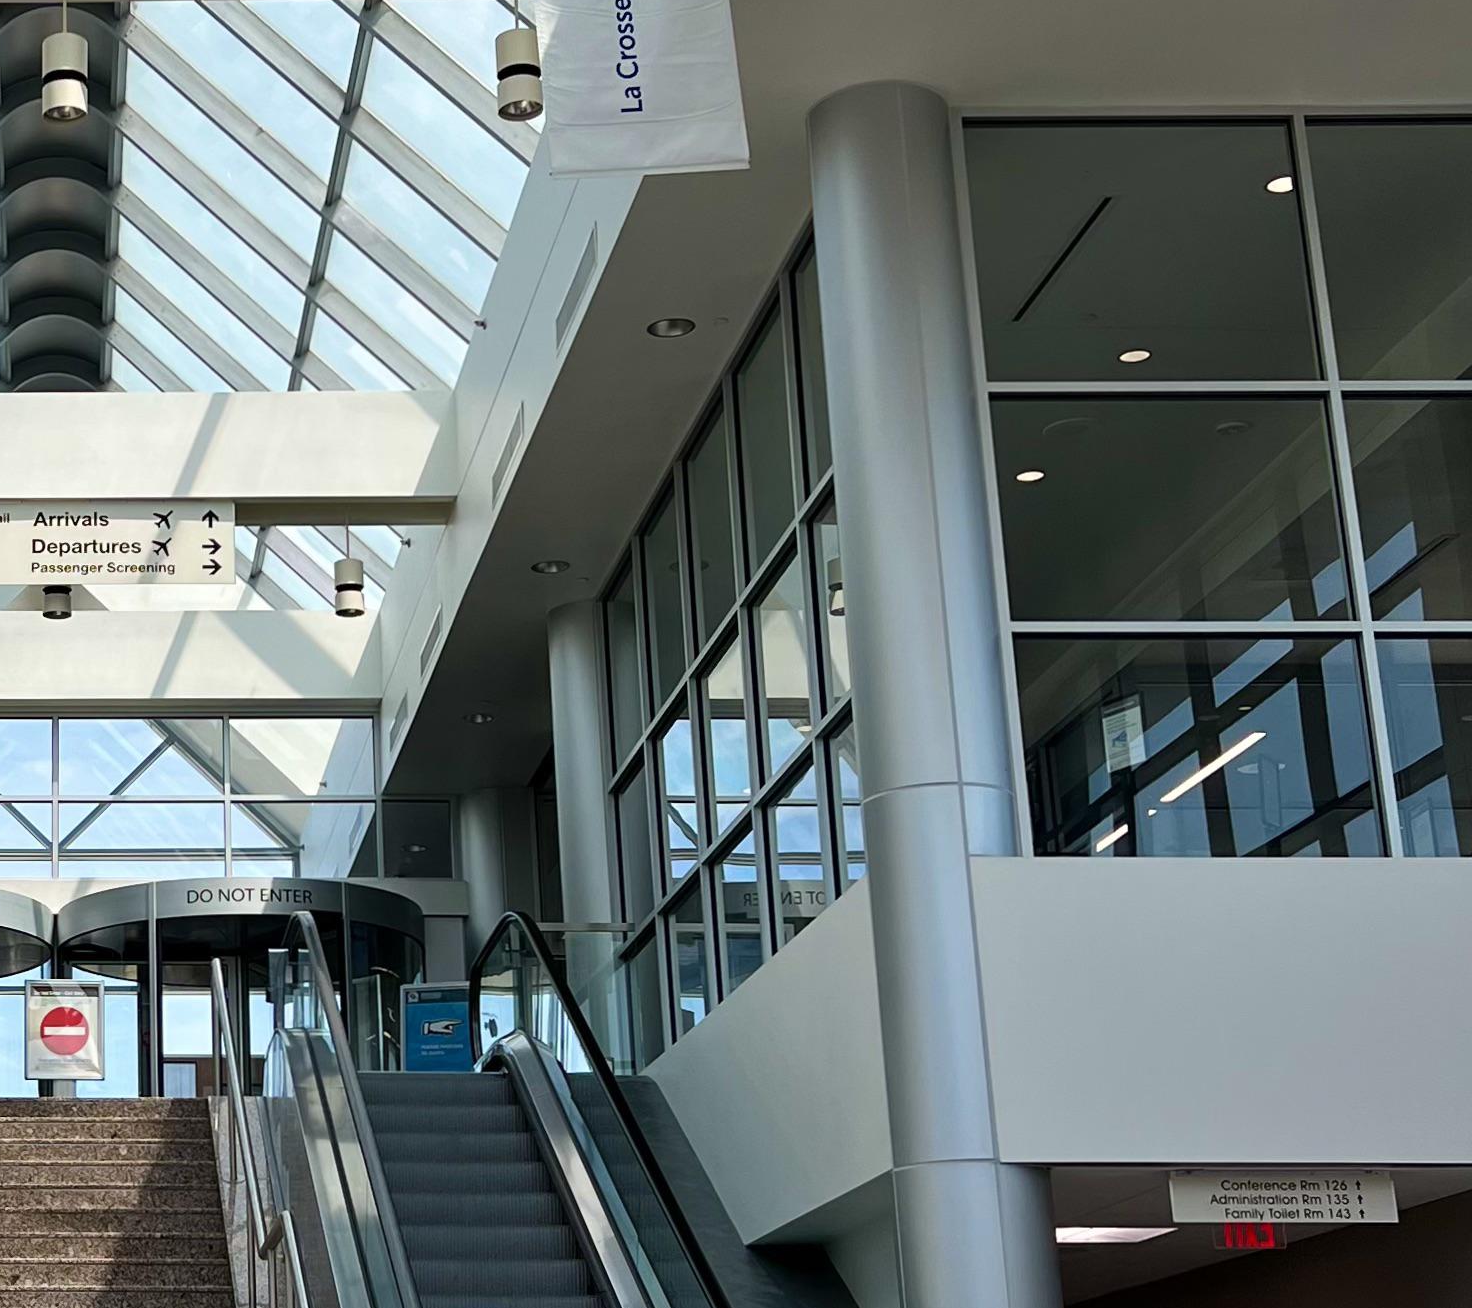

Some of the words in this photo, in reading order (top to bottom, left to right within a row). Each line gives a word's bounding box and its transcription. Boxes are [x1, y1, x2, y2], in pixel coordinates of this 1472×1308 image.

[620, 85, 643, 113] La
[33, 511, 109, 527] Arrivals
[32, 539, 142, 558] Departures
[31, 563, 103, 576] Passenger
[107, 562, 176, 575] Screening
[187, 889, 213, 904] DO
[218, 888, 255, 902] NOT
[260, 888, 313, 904] ENTER
[1221, 1179, 1296, 1191] Conference
[1301, 1180, 1320, 1191] Rm
[1325, 1180, 1347, 1191] 126
[1210, 1194, 1298, 1205] Administration
[1302, 1194, 1321, 1205] Rm
[1327, 1194, 1349, 1205] 135
[1225, 1208, 1265, 1220] Family
[1269, 1208, 1300, 1219] Toilet
[1304, 1208, 1323, 1219] Rm
[1329, 1208, 1351, 1219] 143
